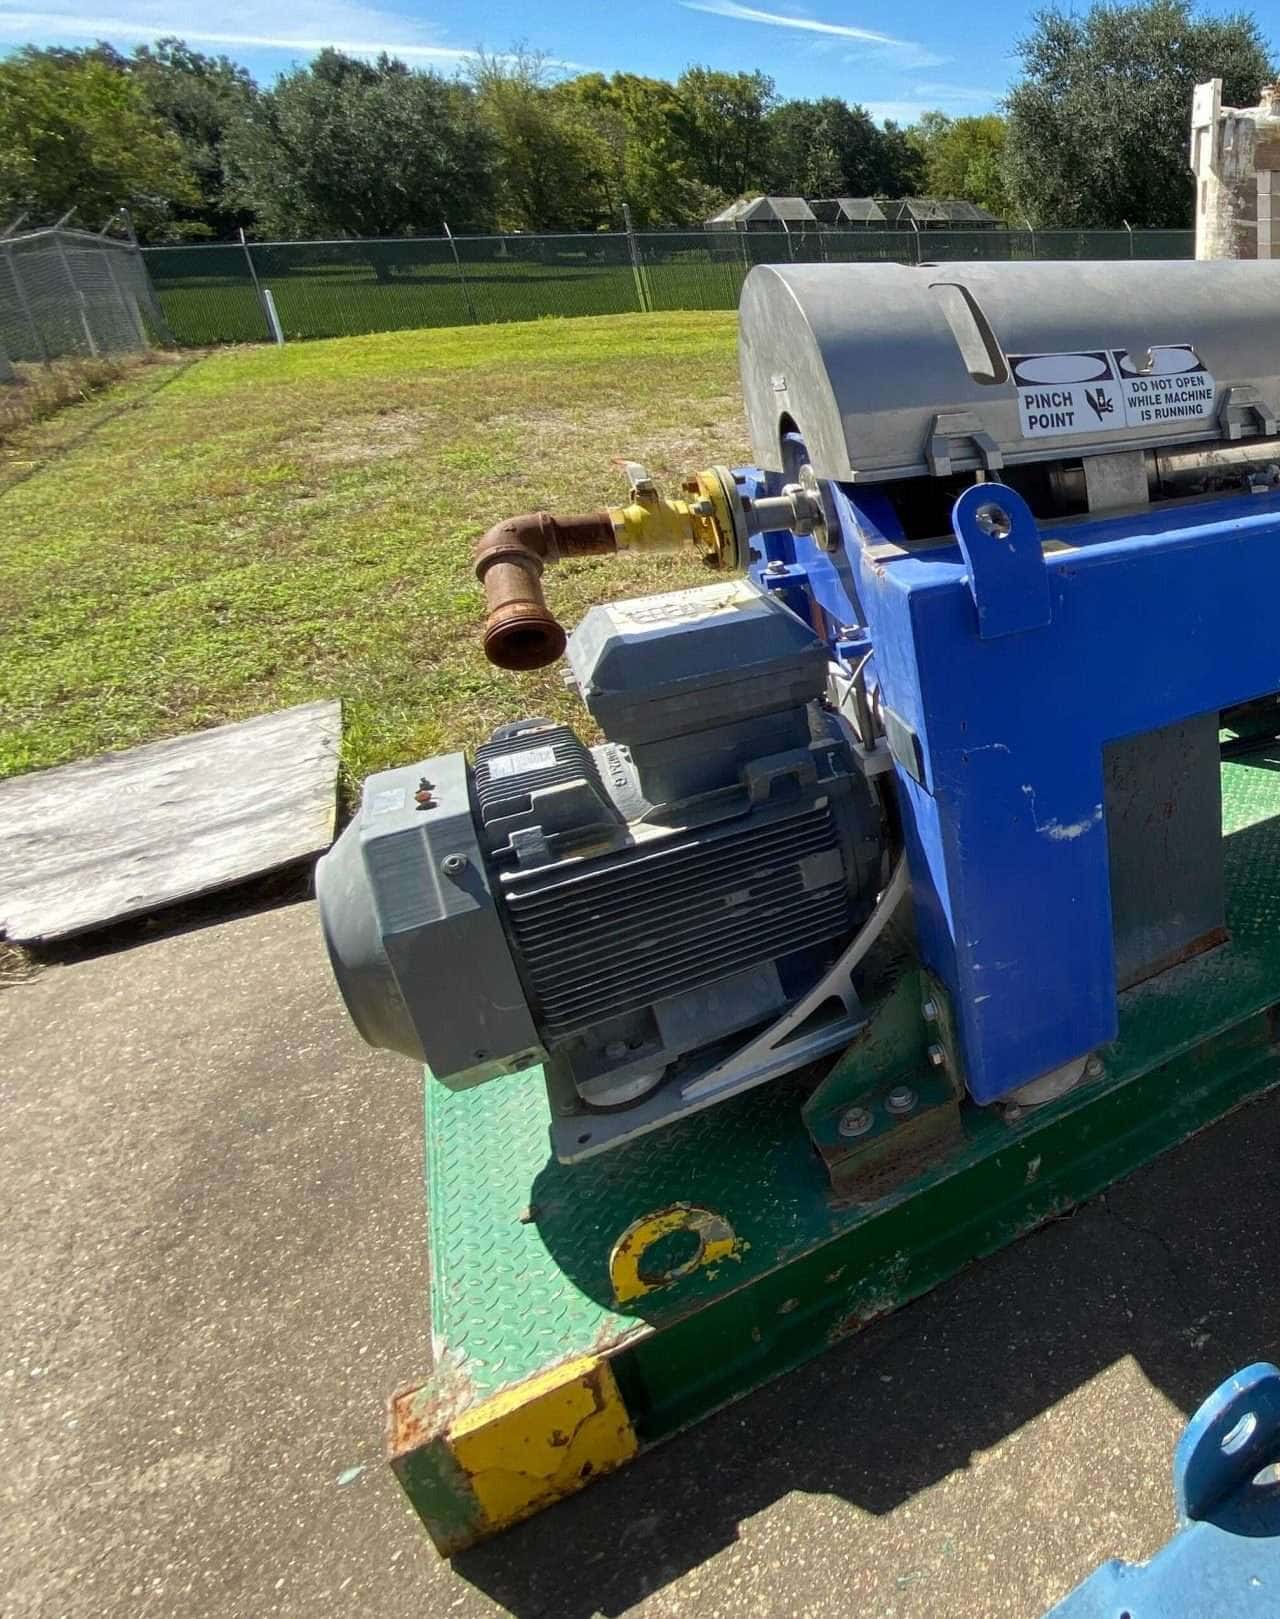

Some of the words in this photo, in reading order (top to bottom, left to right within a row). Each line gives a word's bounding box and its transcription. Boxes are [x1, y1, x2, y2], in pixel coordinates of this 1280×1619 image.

[1132, 381, 1147, 392] DO
[1152, 379, 1172, 391] NOT
[1178, 376, 1204, 388] OPEN
[1024, 392, 1073, 409] PINCH
[1128, 393, 1162, 408] WHILE
[1165, 389, 1212, 405] MACHINE
[1028, 412, 1074, 429] POINT
[1141, 409, 1151, 421] IS
[1155, 404, 1203, 419] RUNNING
